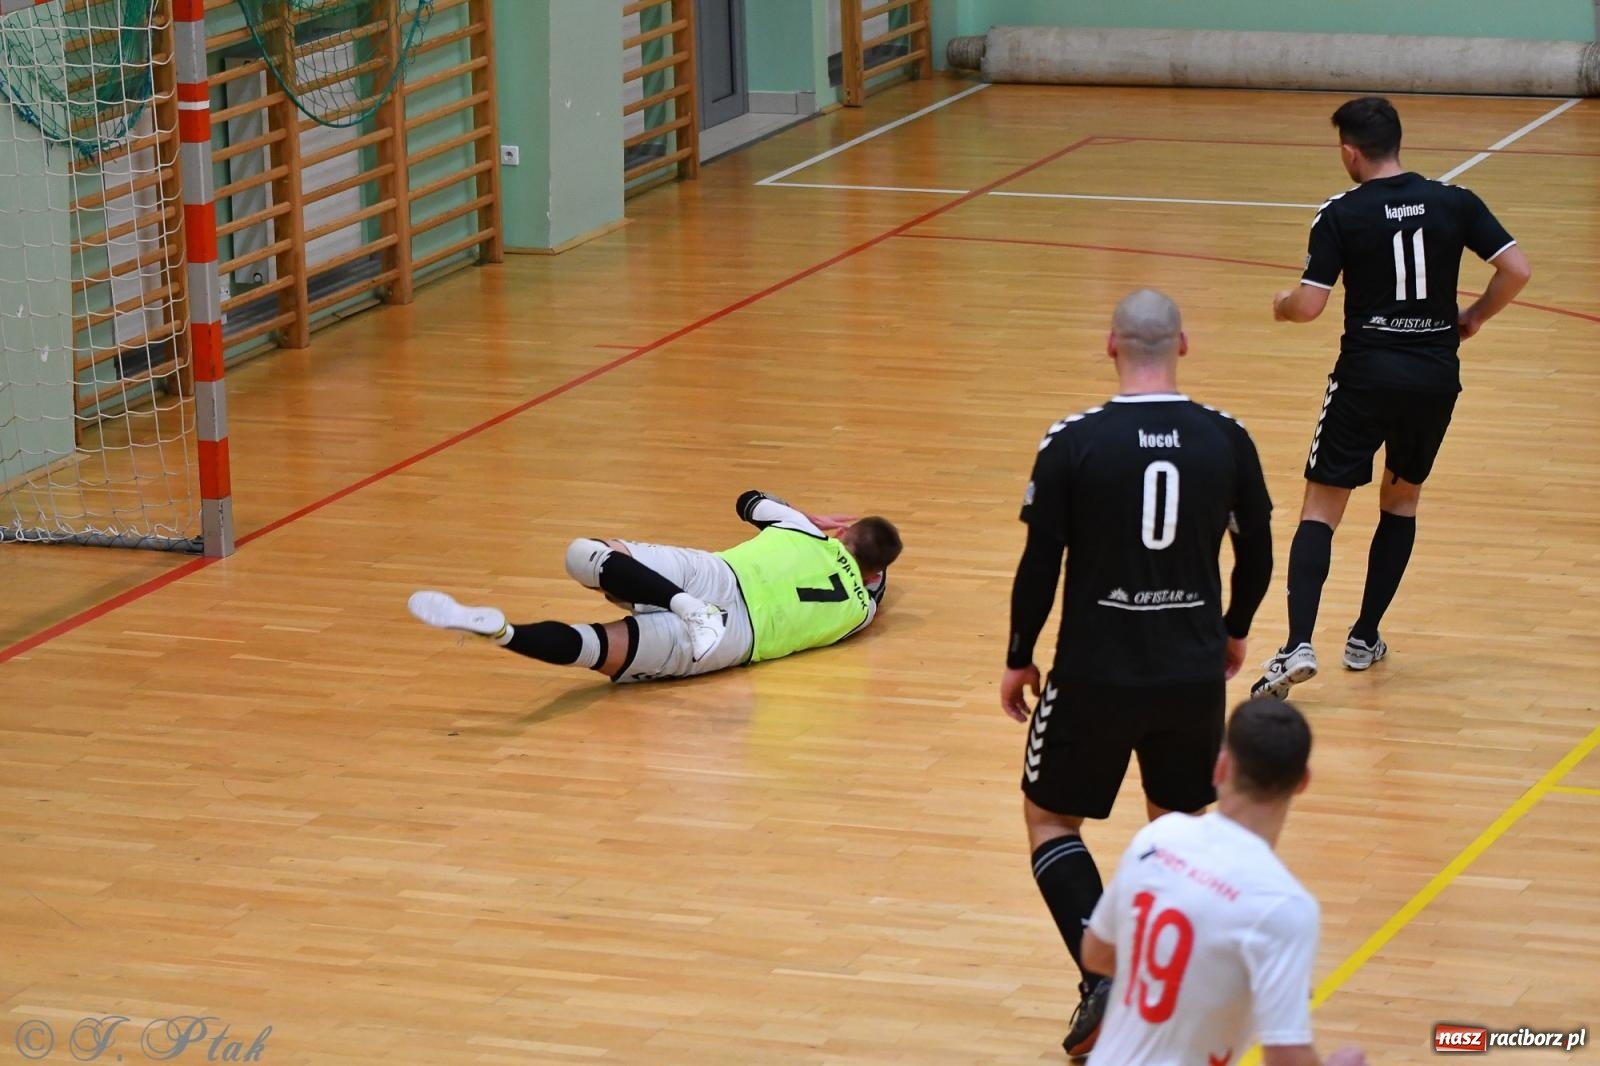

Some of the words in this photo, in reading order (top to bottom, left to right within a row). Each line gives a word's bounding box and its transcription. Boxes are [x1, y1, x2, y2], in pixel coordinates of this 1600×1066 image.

[1384, 203, 1425, 222] kapinos
[1392, 227, 1428, 301] 11
[1390, 318, 1432, 328] OFISTAR
[1138, 429, 1181, 448] kocot
[1141, 460, 1180, 550] 0
[1133, 589, 1184, 604] OFISTAR
[1124, 890, 1195, 1025] 19
